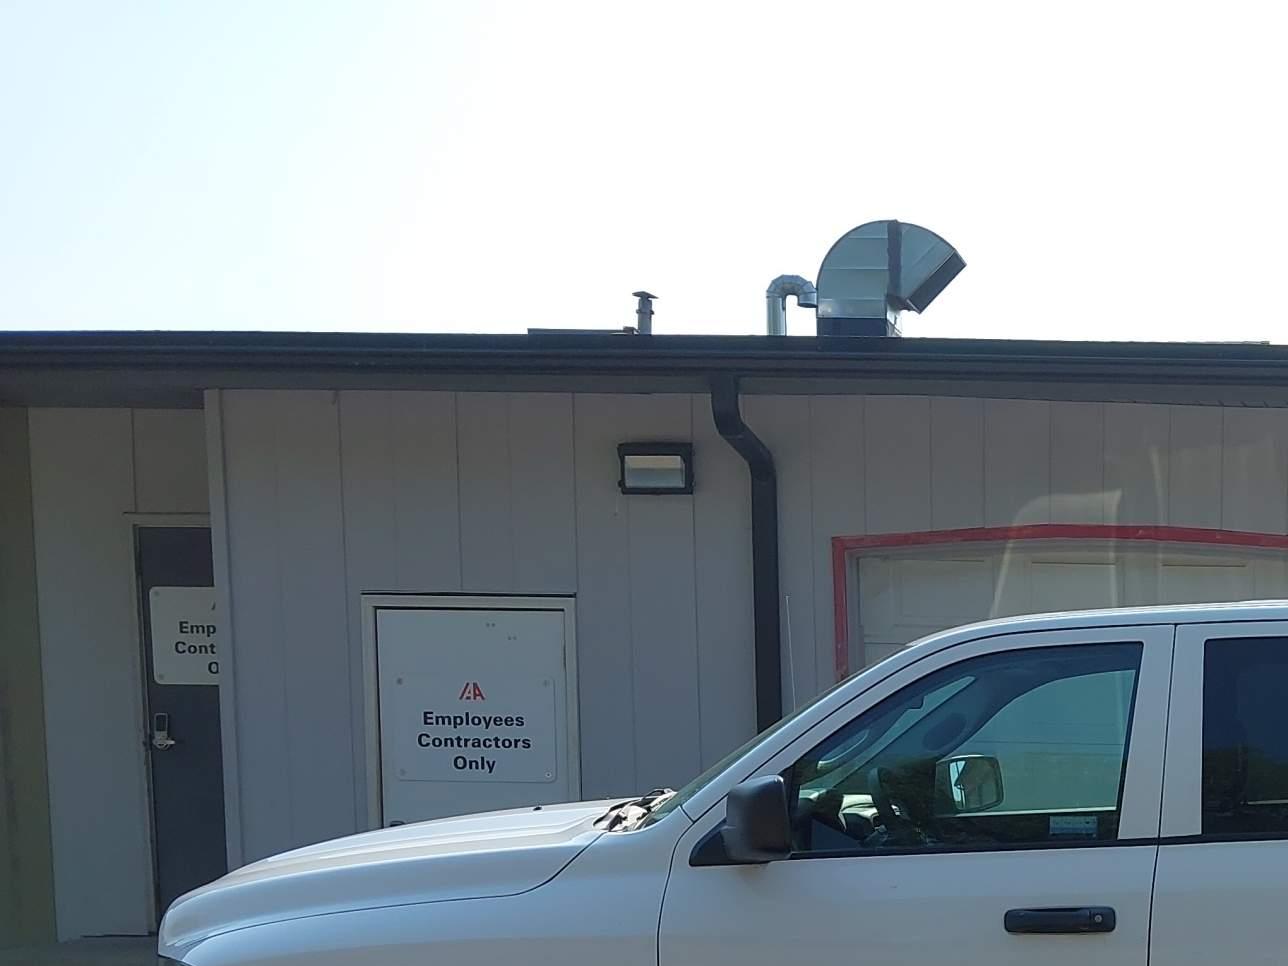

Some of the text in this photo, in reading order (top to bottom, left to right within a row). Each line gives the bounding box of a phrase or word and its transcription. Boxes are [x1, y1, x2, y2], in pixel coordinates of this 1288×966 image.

[423, 711, 525, 729] Employees
[417, 733, 531, 749] Contractors
[453, 755, 496, 773] Only
